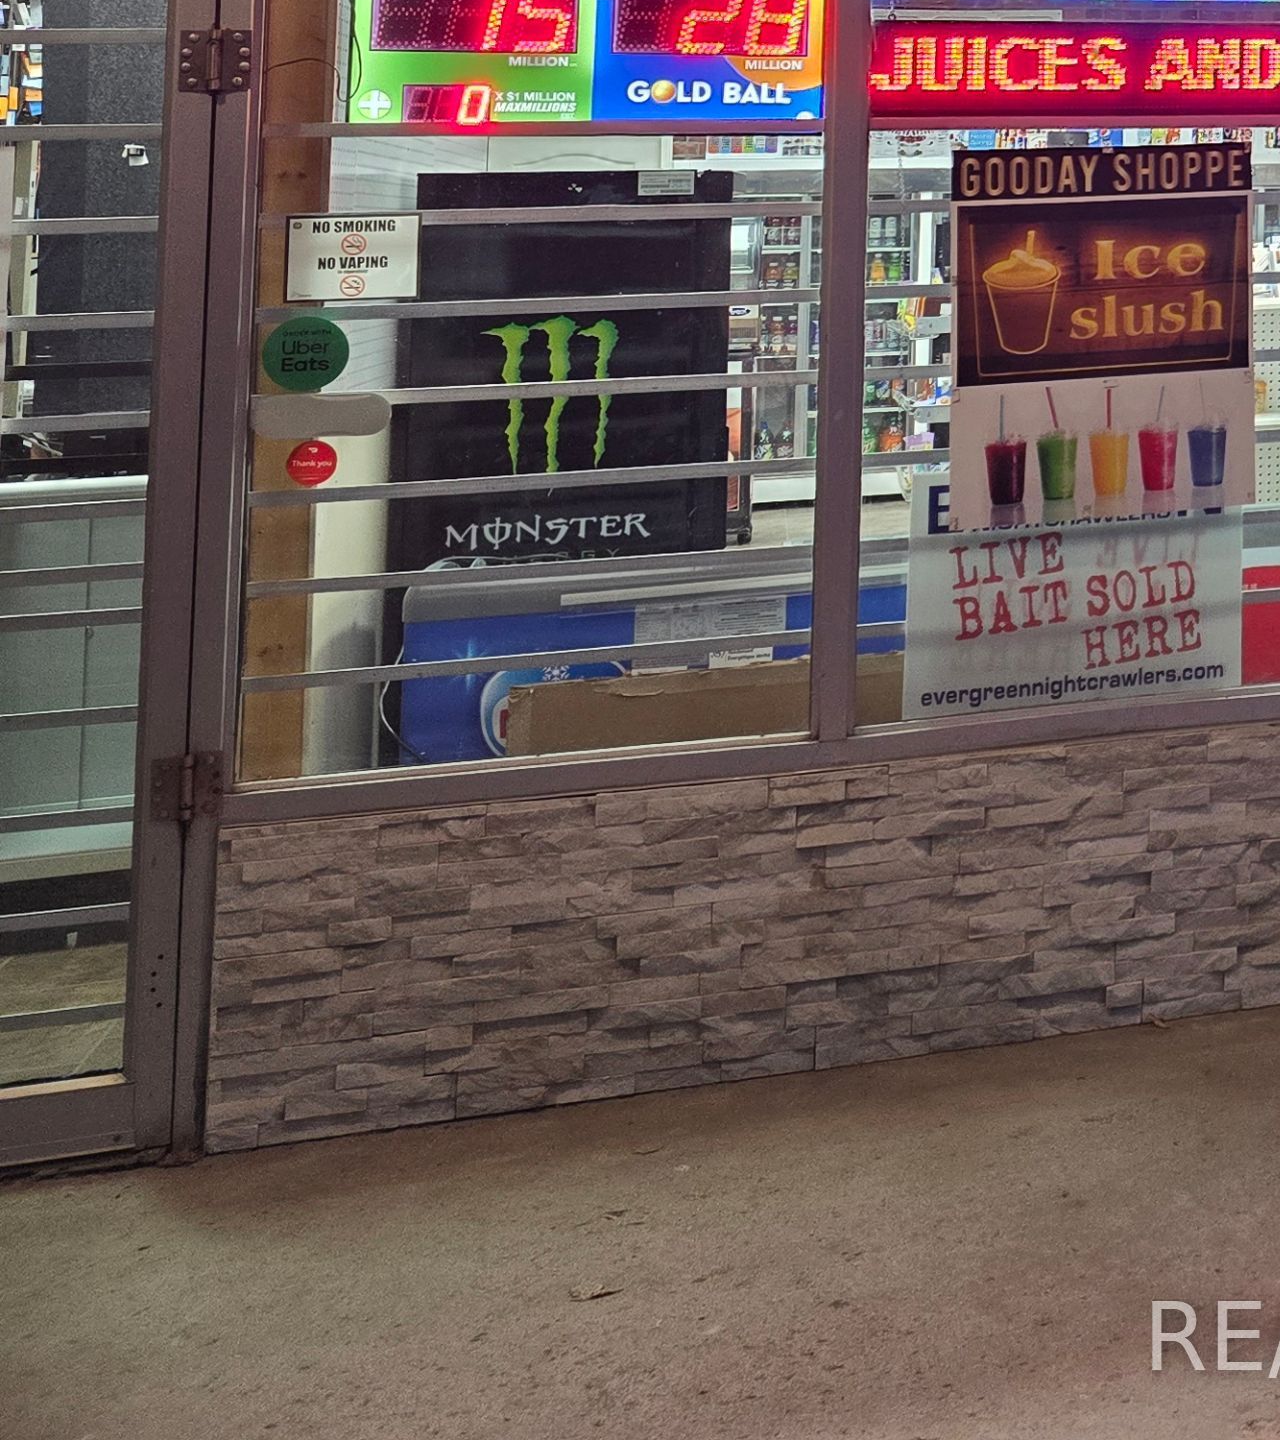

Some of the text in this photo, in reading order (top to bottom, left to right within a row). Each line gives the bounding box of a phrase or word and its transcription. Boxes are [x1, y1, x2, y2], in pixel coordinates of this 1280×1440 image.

[508, 56, 569, 68] MILLION
[745, 59, 803, 71] MILLION
[869, 35, 1128, 93] JUICES
[457, 85, 492, 126] 0
[507, 91, 519, 102] $1
[524, 91, 576, 102] MILLION
[493, 102, 577, 113] MAXMILLIONS
[627, 80, 792, 105] GOLD BALL
[959, 150, 1246, 198] GOODAY SHOPPE
[312, 219, 397, 234] NO SMOKING
[317, 256, 389, 270] NO VAPING
[1094, 237, 1208, 282] Ice
[1069, 290, 1226, 340] slush
[281, 340, 329, 356] Uber
[281, 357, 330, 373] Eats
[292, 460, 332, 469] Thank you
[443, 512, 652, 552] MONSTER
[949, 531, 1066, 591] LIVE
[952, 560, 1197, 642] BAIT SOLD
[1080, 609, 1203, 671] HERE
[920, 661, 1226, 708] evergreennightcrawlers.com
